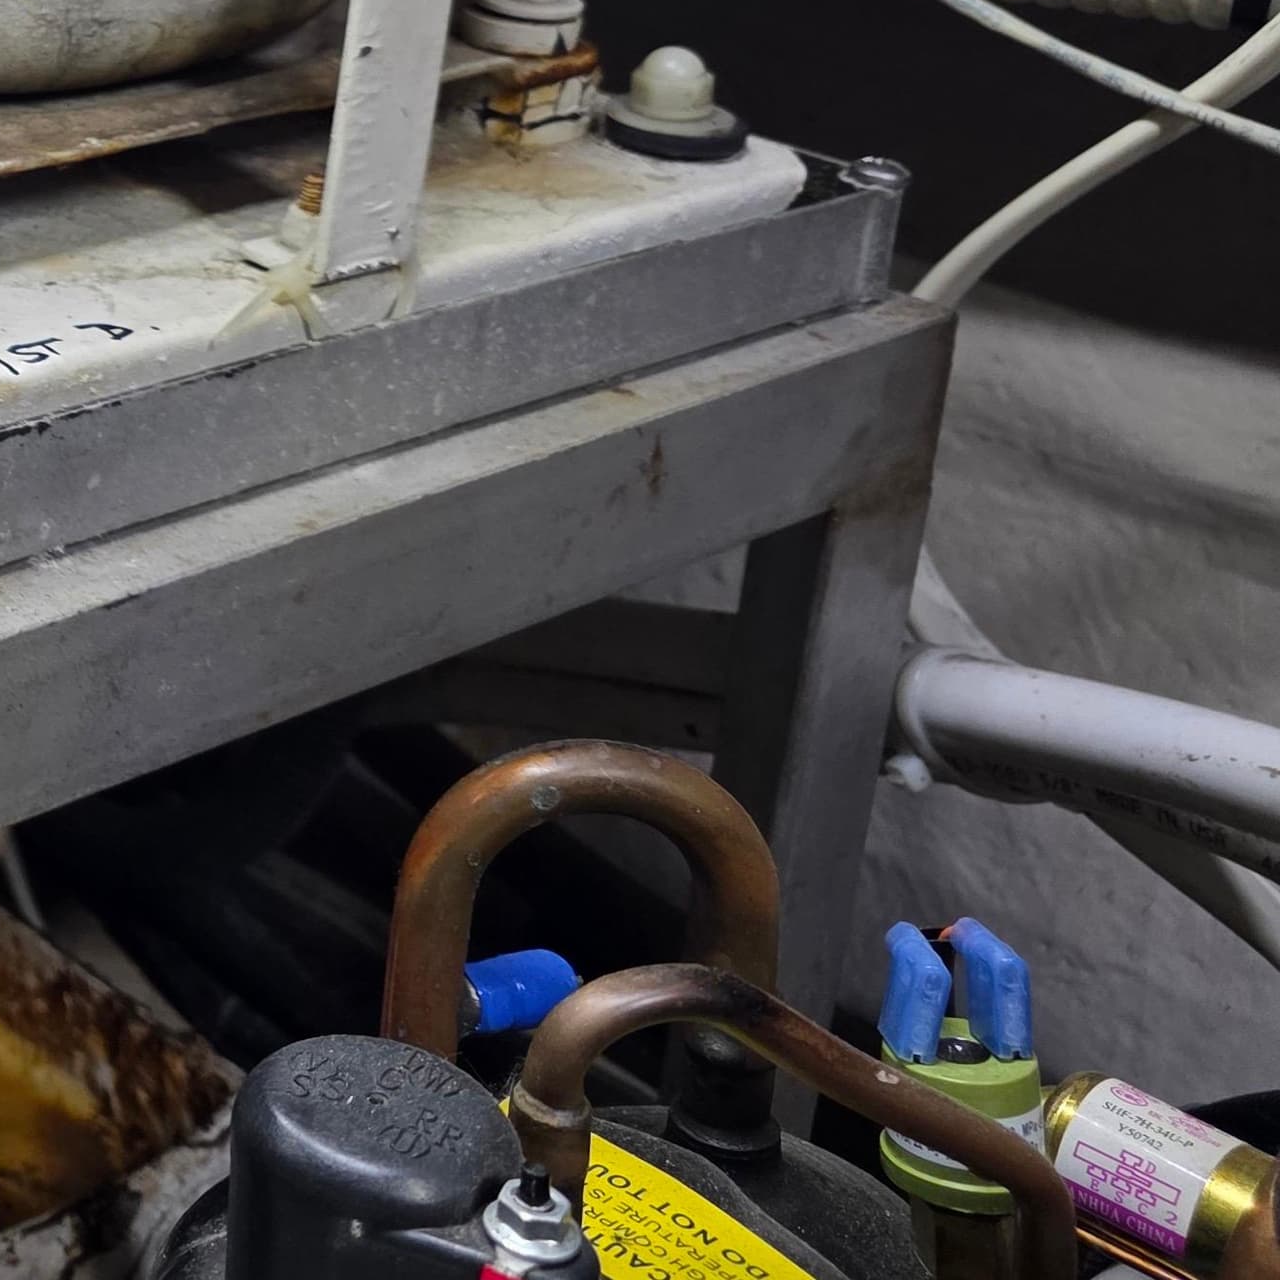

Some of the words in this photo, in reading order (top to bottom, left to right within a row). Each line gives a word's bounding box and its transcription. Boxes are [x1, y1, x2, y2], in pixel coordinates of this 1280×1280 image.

[589, 1164, 648, 1201] TOU
[1146, 1160, 1157, 1174] D
[589, 1187, 614, 1204] IS
[1138, 1202, 1149, 1215] C
[1165, 1211, 1178, 1225] 2
[583, 1202, 668, 1258] COMPR
[614, 1202, 737, 1280] PERATURE
[649, 1200, 719, 1246] NOT
[1126, 1213, 1176, 1251] CHINA
[582, 1226, 672, 1280] CAUT
[721, 1248, 770, 1280] DO
